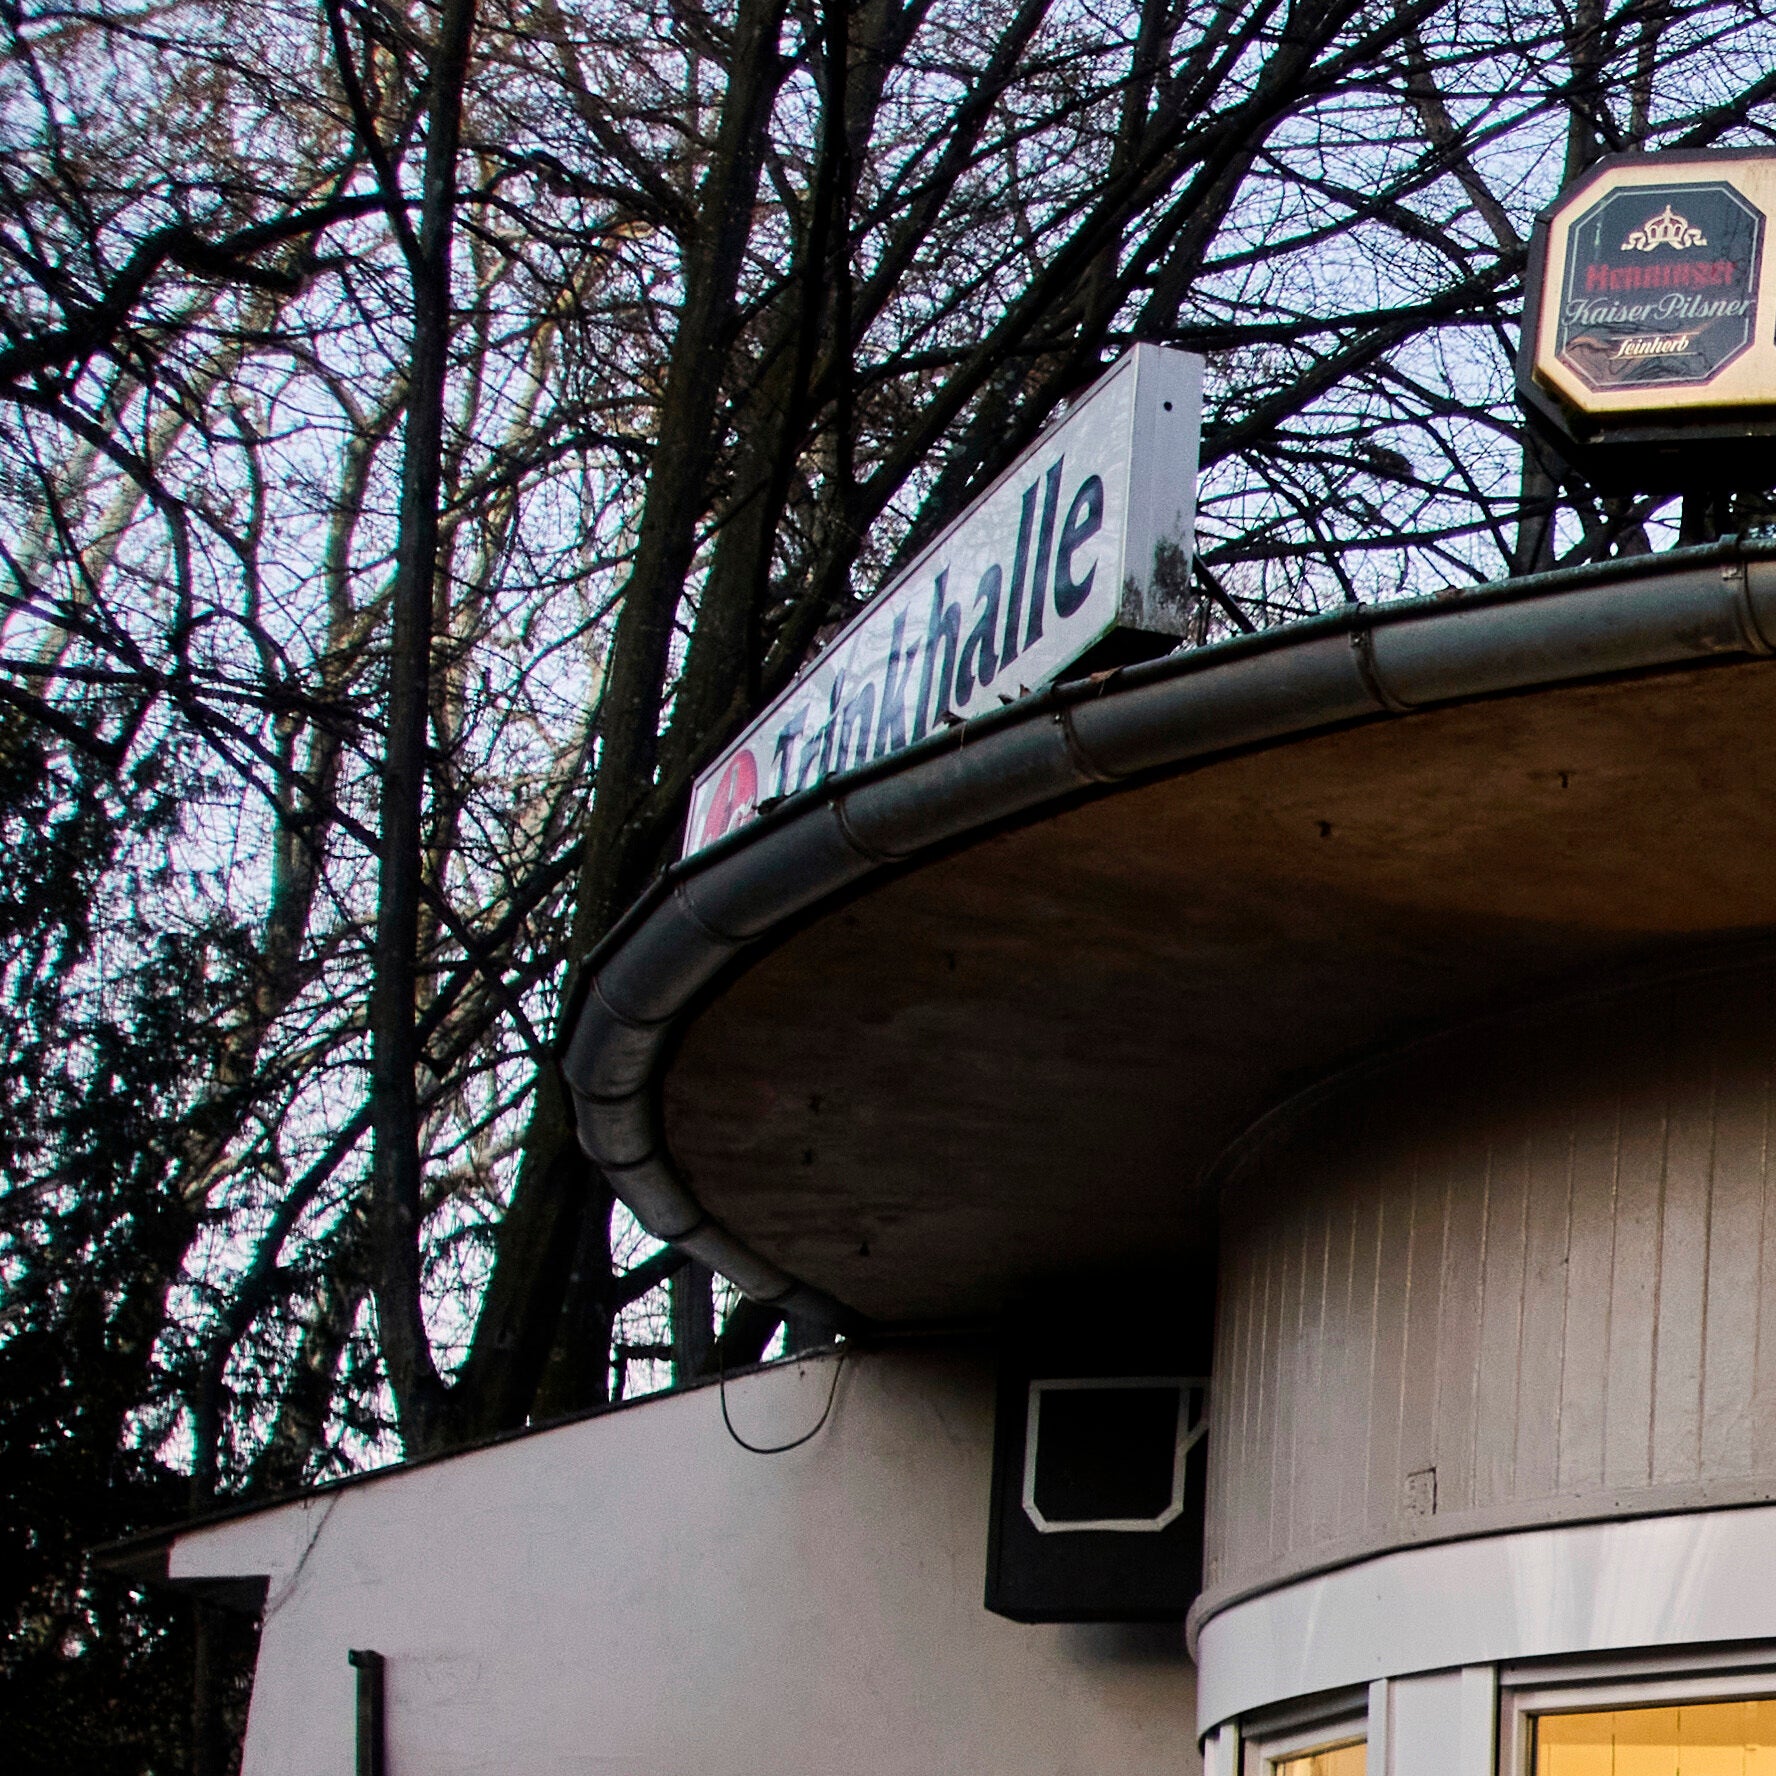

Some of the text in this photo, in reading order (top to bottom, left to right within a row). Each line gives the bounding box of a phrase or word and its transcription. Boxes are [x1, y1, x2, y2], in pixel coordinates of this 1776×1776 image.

[1562, 293, 1756, 327] Kaiser Pilsner
[1612, 333, 1690, 358] feinherb
